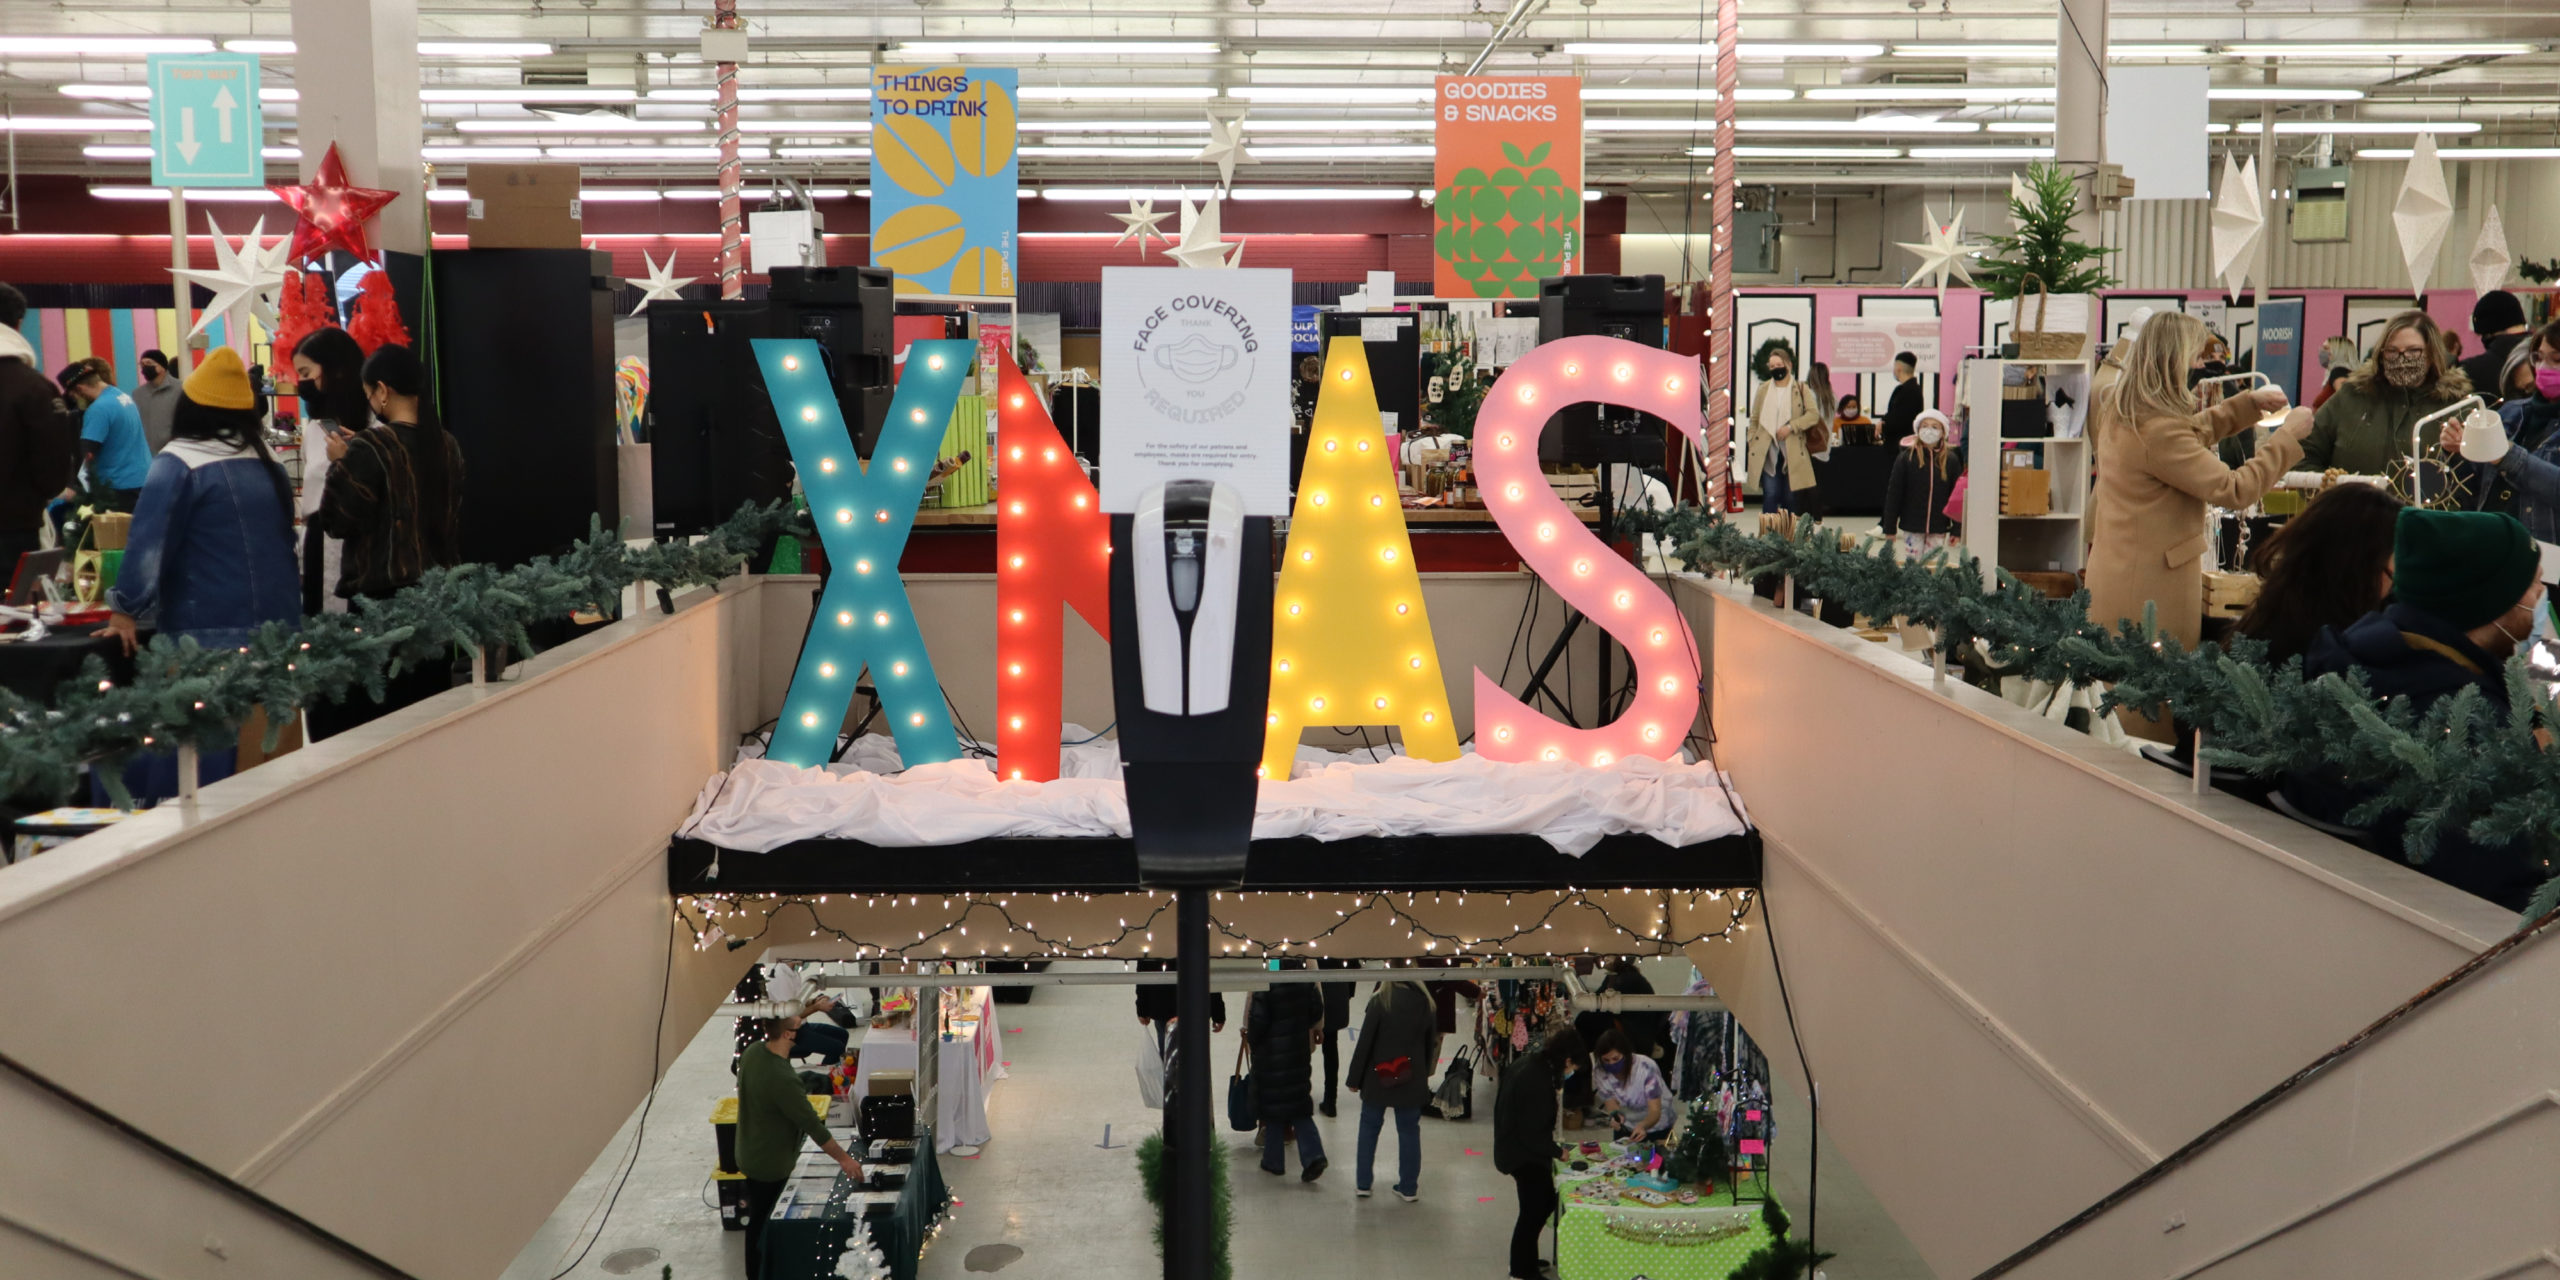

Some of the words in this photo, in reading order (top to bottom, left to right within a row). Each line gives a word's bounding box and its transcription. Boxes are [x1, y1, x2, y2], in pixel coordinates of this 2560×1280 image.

[171, 67, 204, 80] TWO
[207, 67, 238, 80] WAY
[878, 75, 968, 92] THINGS
[1444, 82, 1547, 99] GOODIES
[878, 99, 909, 115] TO
[915, 100, 988, 117] DRINK
[1444, 105, 1459, 121] &
[1466, 105, 1558, 122] SNACKS
[1001, 230, 1010, 249] THE
[1563, 231, 1572, 250] THE
[1001, 250, 1009, 289] PUBLIC
[1563, 251, 1572, 276] PUBL
[1134, 306, 1169, 352] FACE
[1172, 295, 1258, 353] COVERING
[1181, 319, 1213, 327] THANK
[2262, 327, 2294, 341] NOORISH
[1187, 390, 1205, 398] YOU
[1144, 388, 1246, 424] REQUIRED
